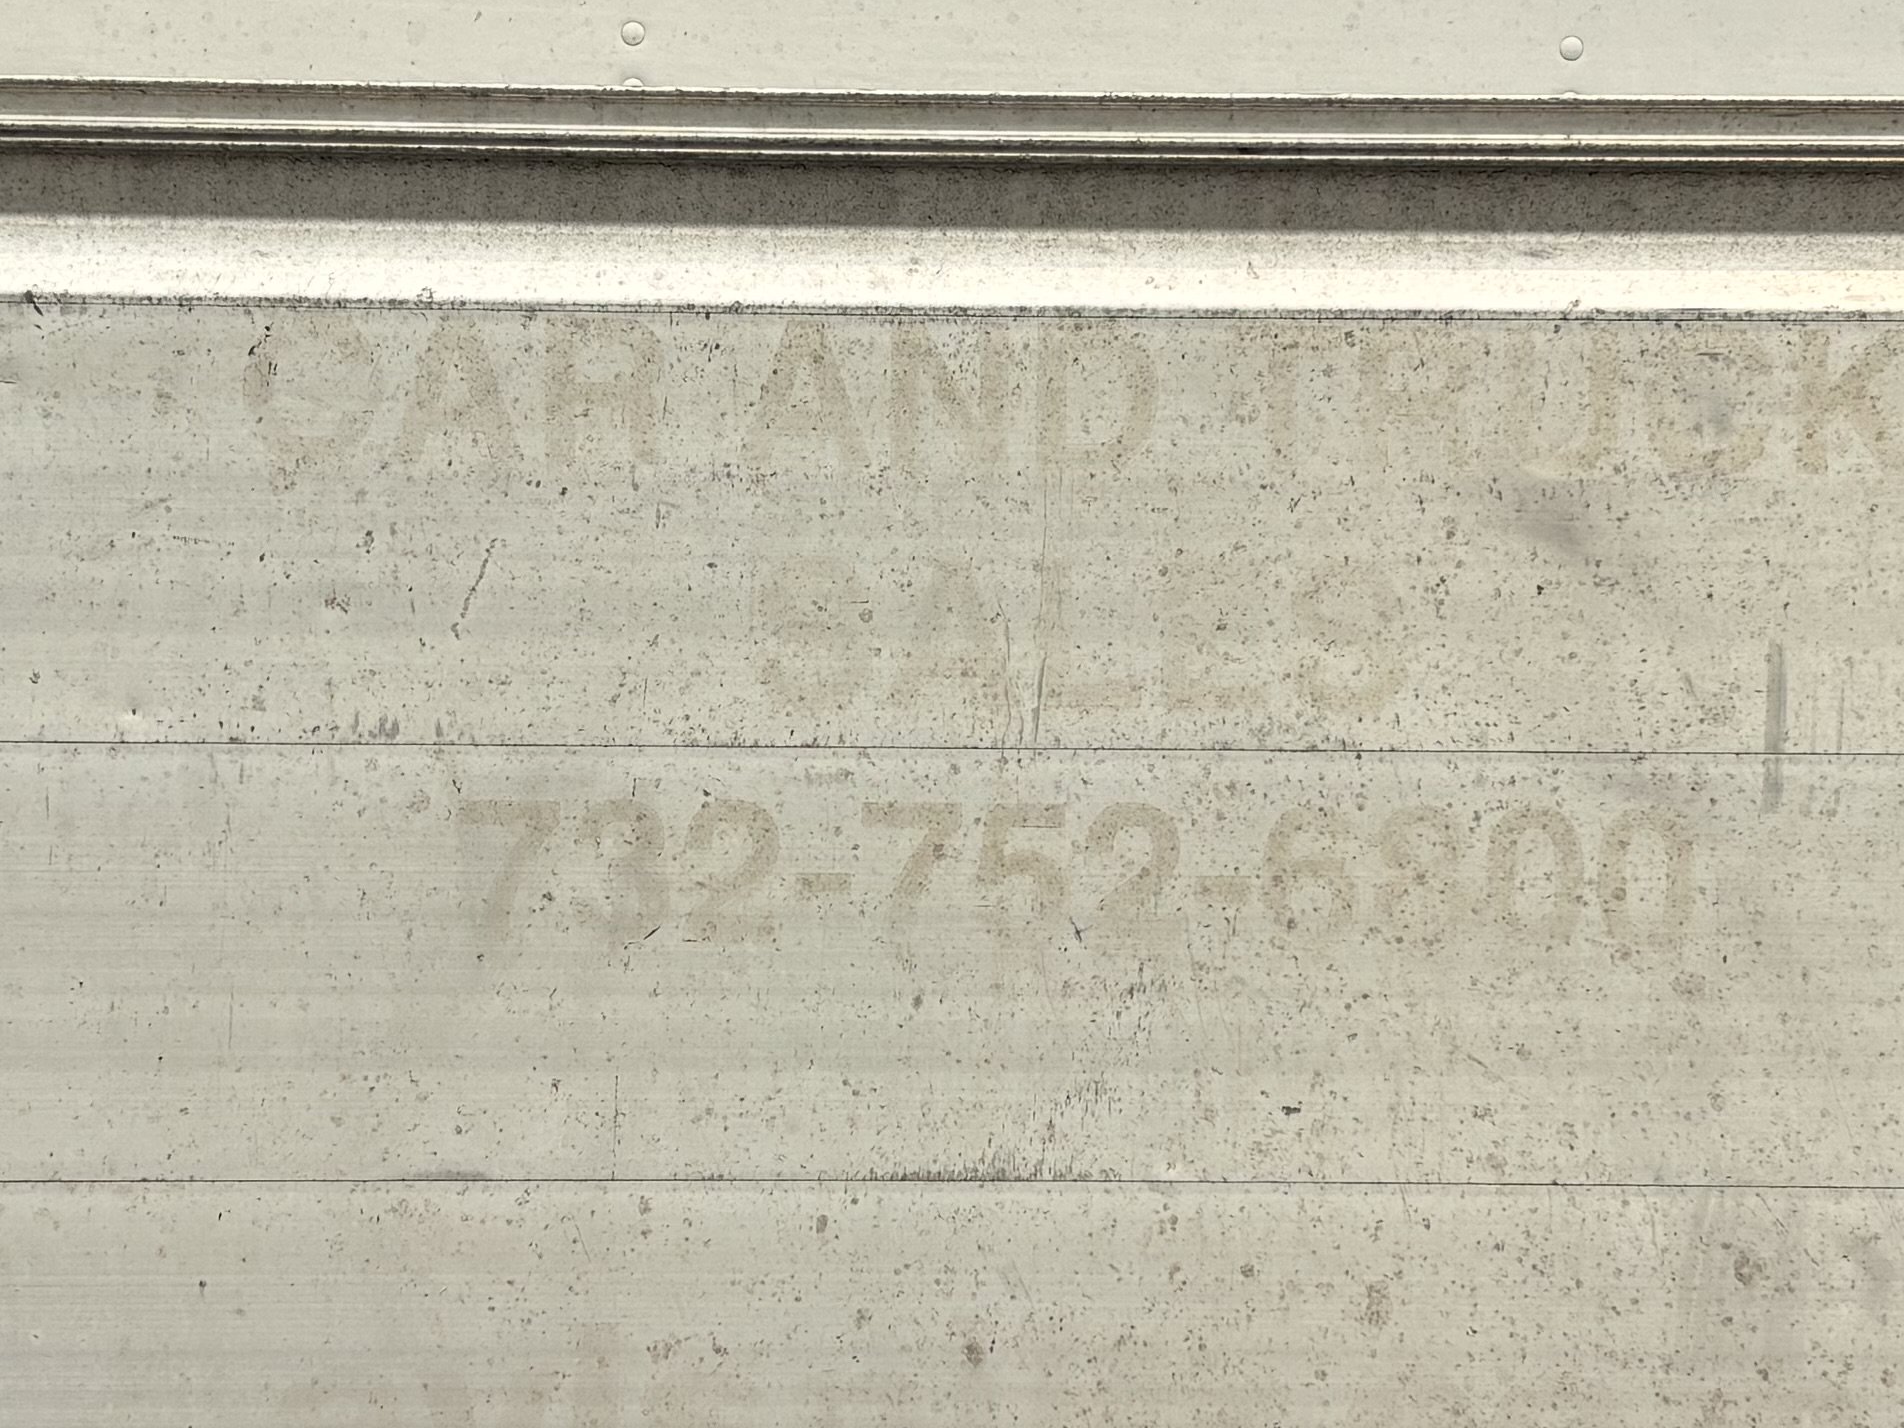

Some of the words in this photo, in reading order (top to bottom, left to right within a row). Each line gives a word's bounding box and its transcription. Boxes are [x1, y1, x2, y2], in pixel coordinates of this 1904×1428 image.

[244, 320, 664, 476] CAR
[739, 320, 1162, 476] AND
[453, 798, 1700, 956] 732-752-6800
